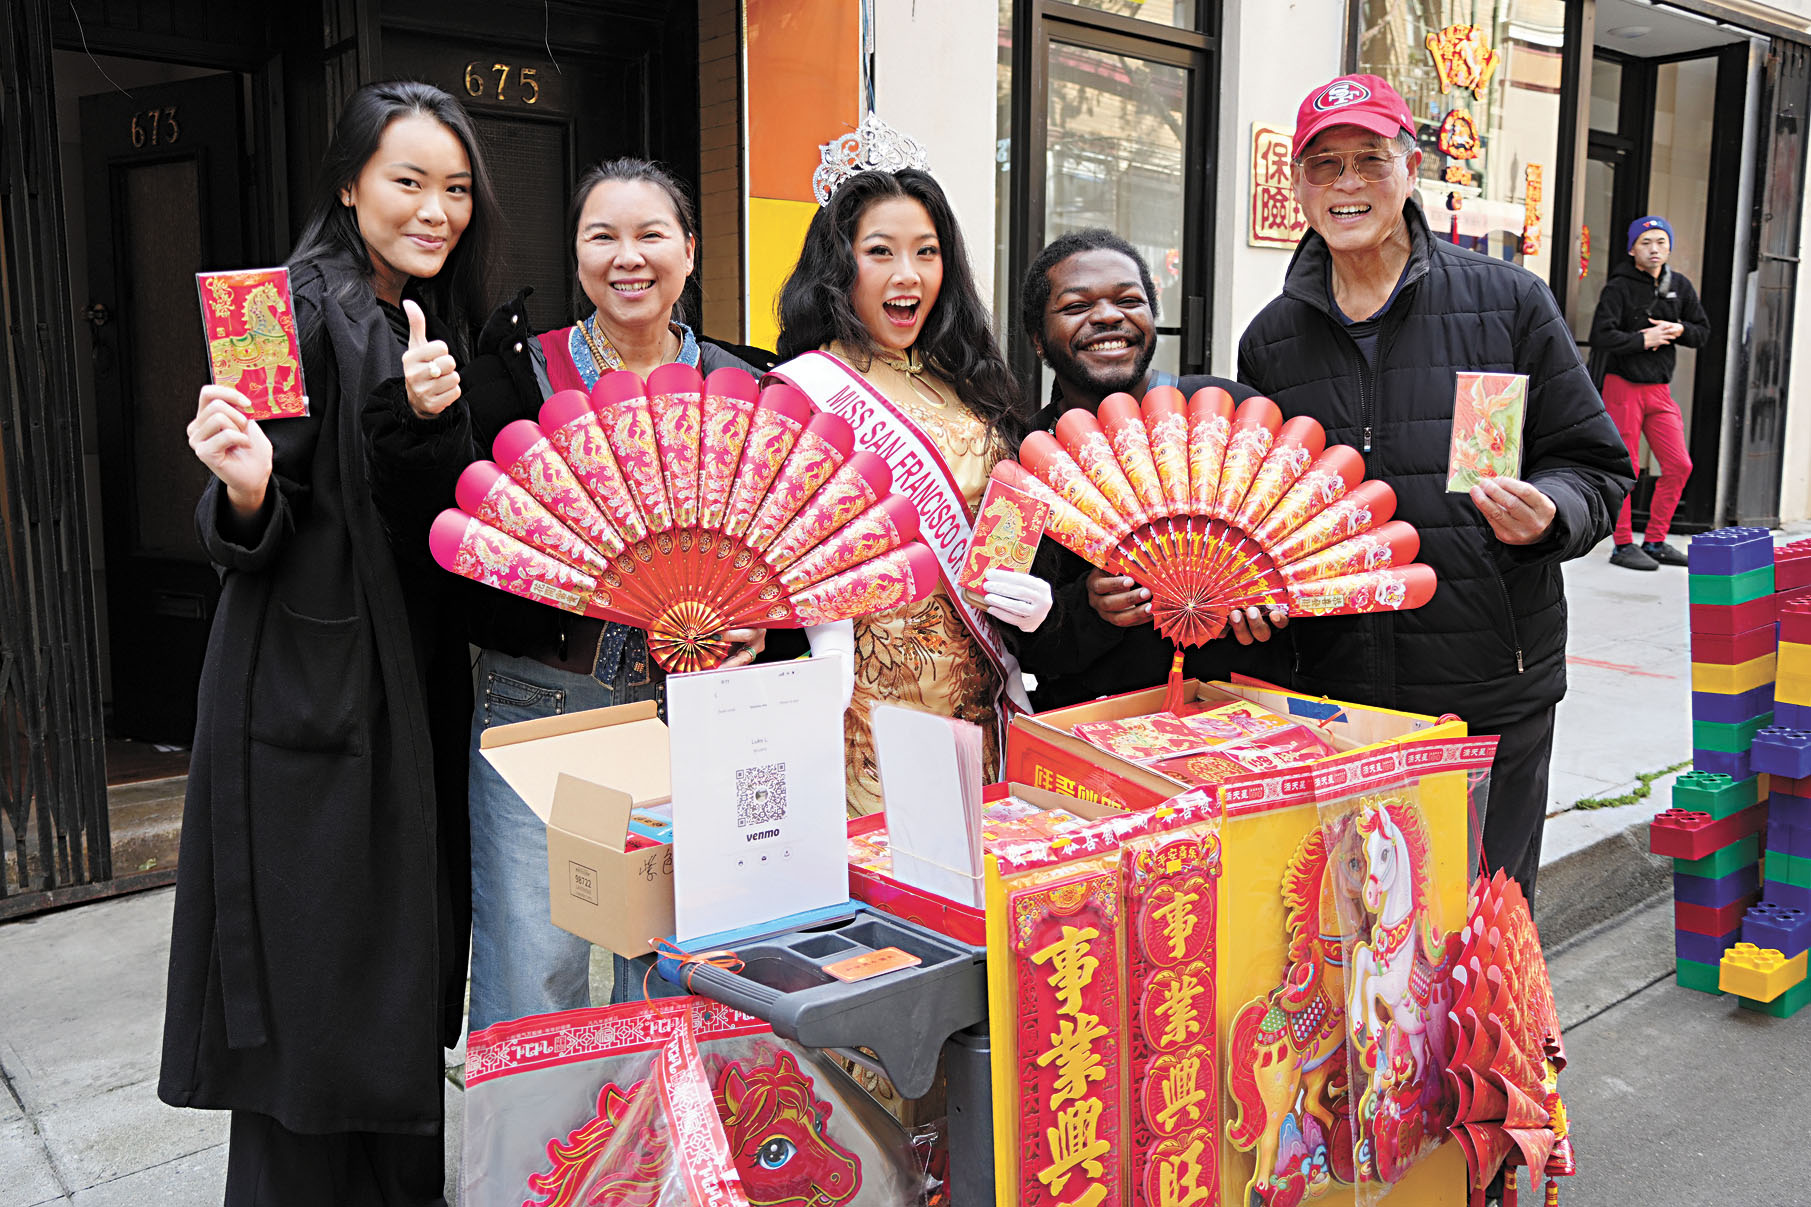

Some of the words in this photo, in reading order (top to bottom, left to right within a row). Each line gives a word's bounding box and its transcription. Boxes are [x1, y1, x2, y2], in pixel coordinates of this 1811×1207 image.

[131, 105, 181, 149] 673
[463, 60, 541, 105] 675
[1261, 140, 1289, 231] 保險
[825, 384, 874, 433] MISS
[860, 420, 907, 461] SAN
[891, 450, 961, 550] FRANCISCO
[746, 827, 780, 842] venmo
[1030, 925, 1111, 1207] 事業興
[1152, 891, 1210, 1207] 事業興旺
